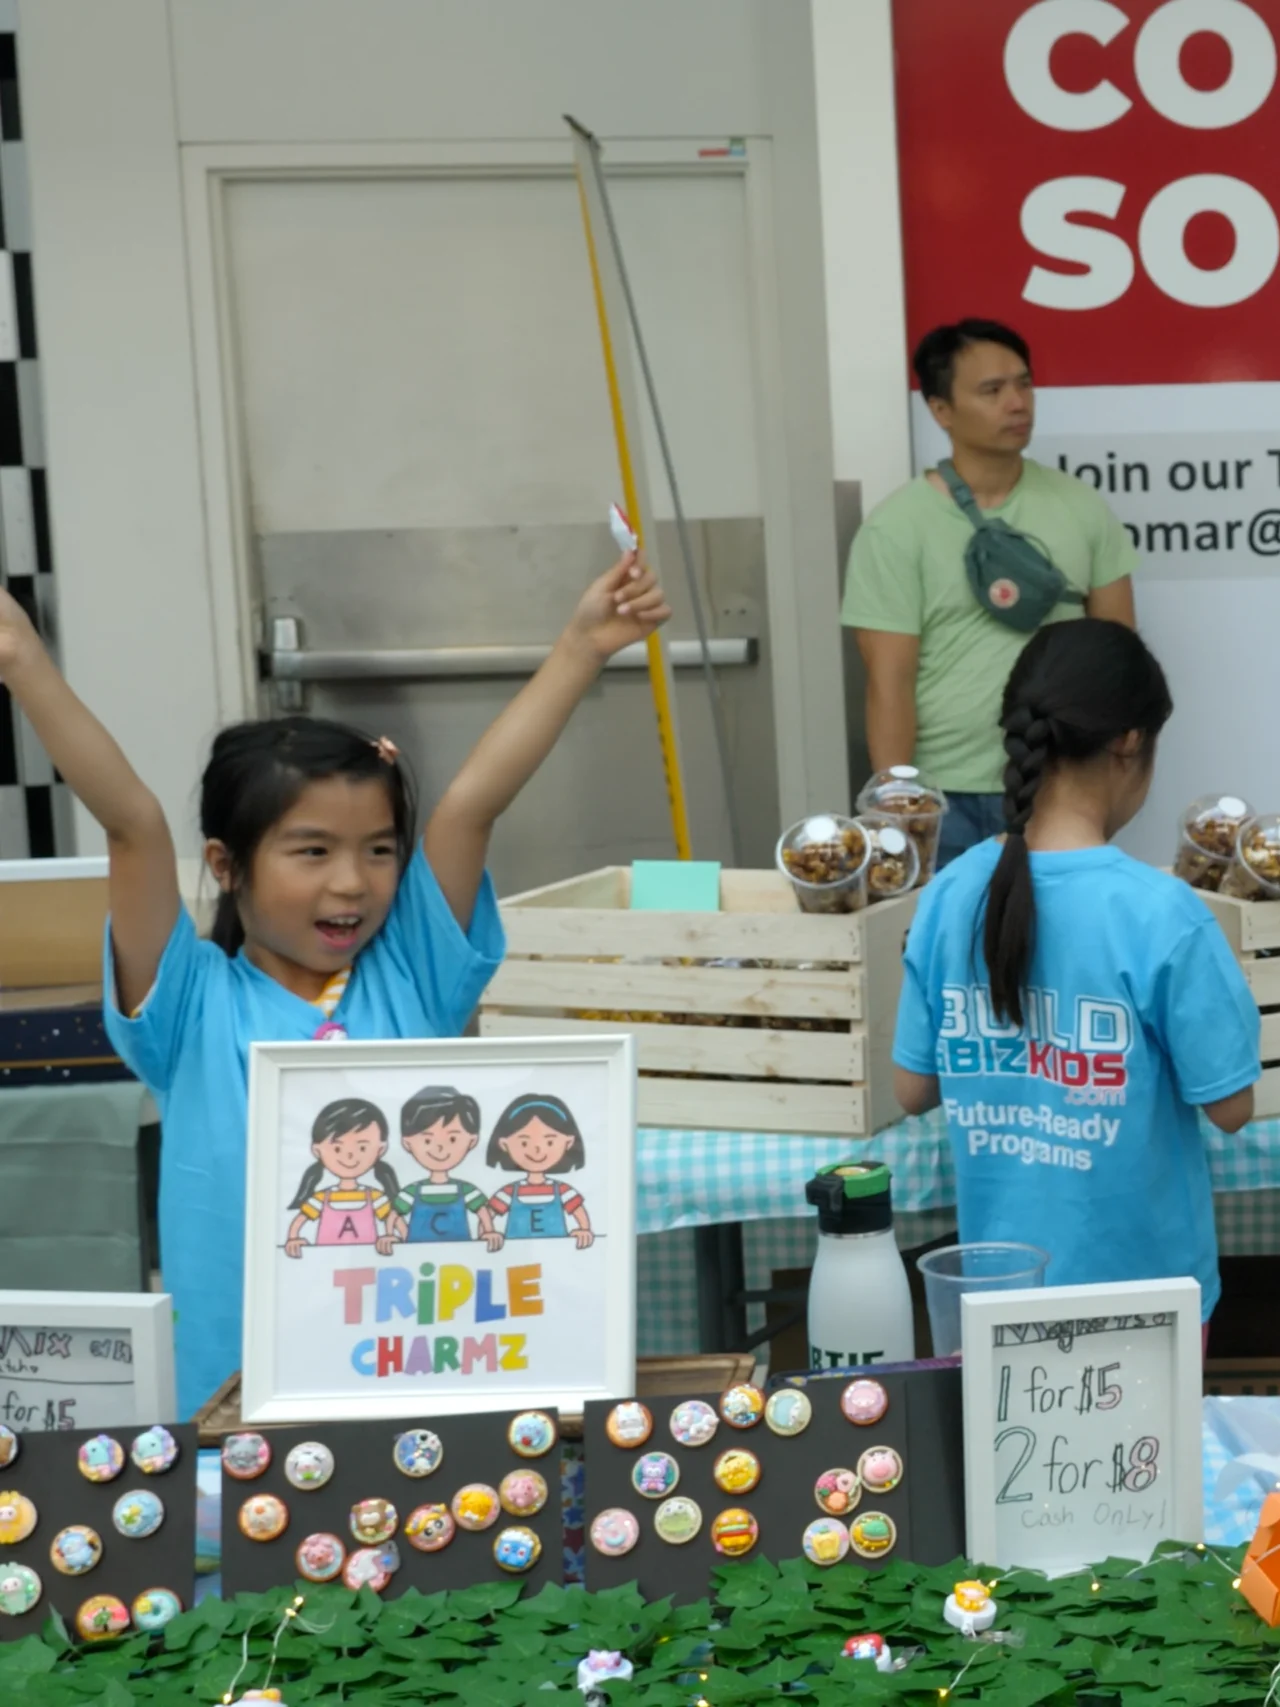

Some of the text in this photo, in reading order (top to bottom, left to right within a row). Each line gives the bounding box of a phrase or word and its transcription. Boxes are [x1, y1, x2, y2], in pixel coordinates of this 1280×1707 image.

[1167, 459, 1251, 492] our
[338, 1209, 545, 1240] A C E
[350, 1332, 529, 1378] CHARMZ
[2, 1391, 40, 1422] for
[997, 1361, 1123, 1422] 1 for $5
[993, 1425, 1160, 1505] 2 for $8
[1021, 1504, 1075, 1529] Cash
